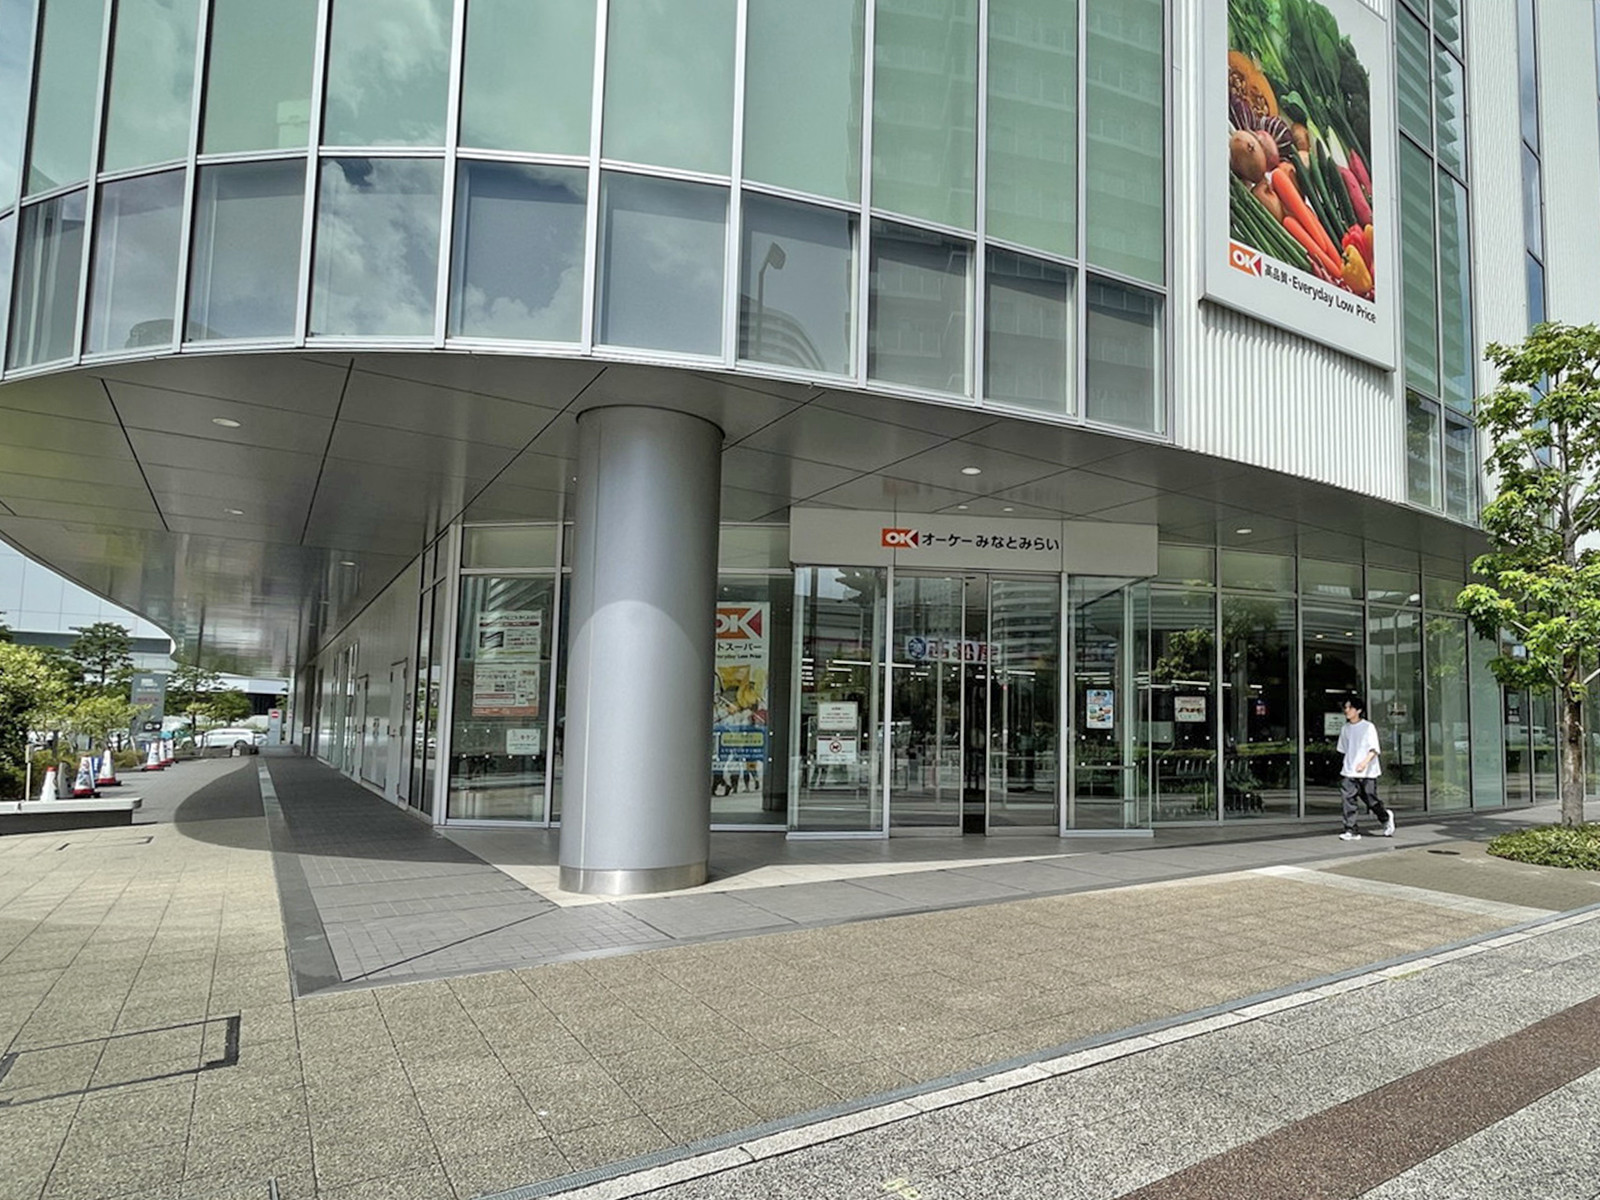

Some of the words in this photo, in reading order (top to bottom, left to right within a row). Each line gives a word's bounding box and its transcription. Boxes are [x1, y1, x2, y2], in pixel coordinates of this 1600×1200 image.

[1231, 247, 1263, 277] OK
[1335, 295, 1354, 314] Low
[1356, 304, 1377, 323] Price
[884, 529, 918, 548] OK
[922, 533, 1059, 551] オーケーみなとみらい
[717, 643, 762, 651] トスーパー
